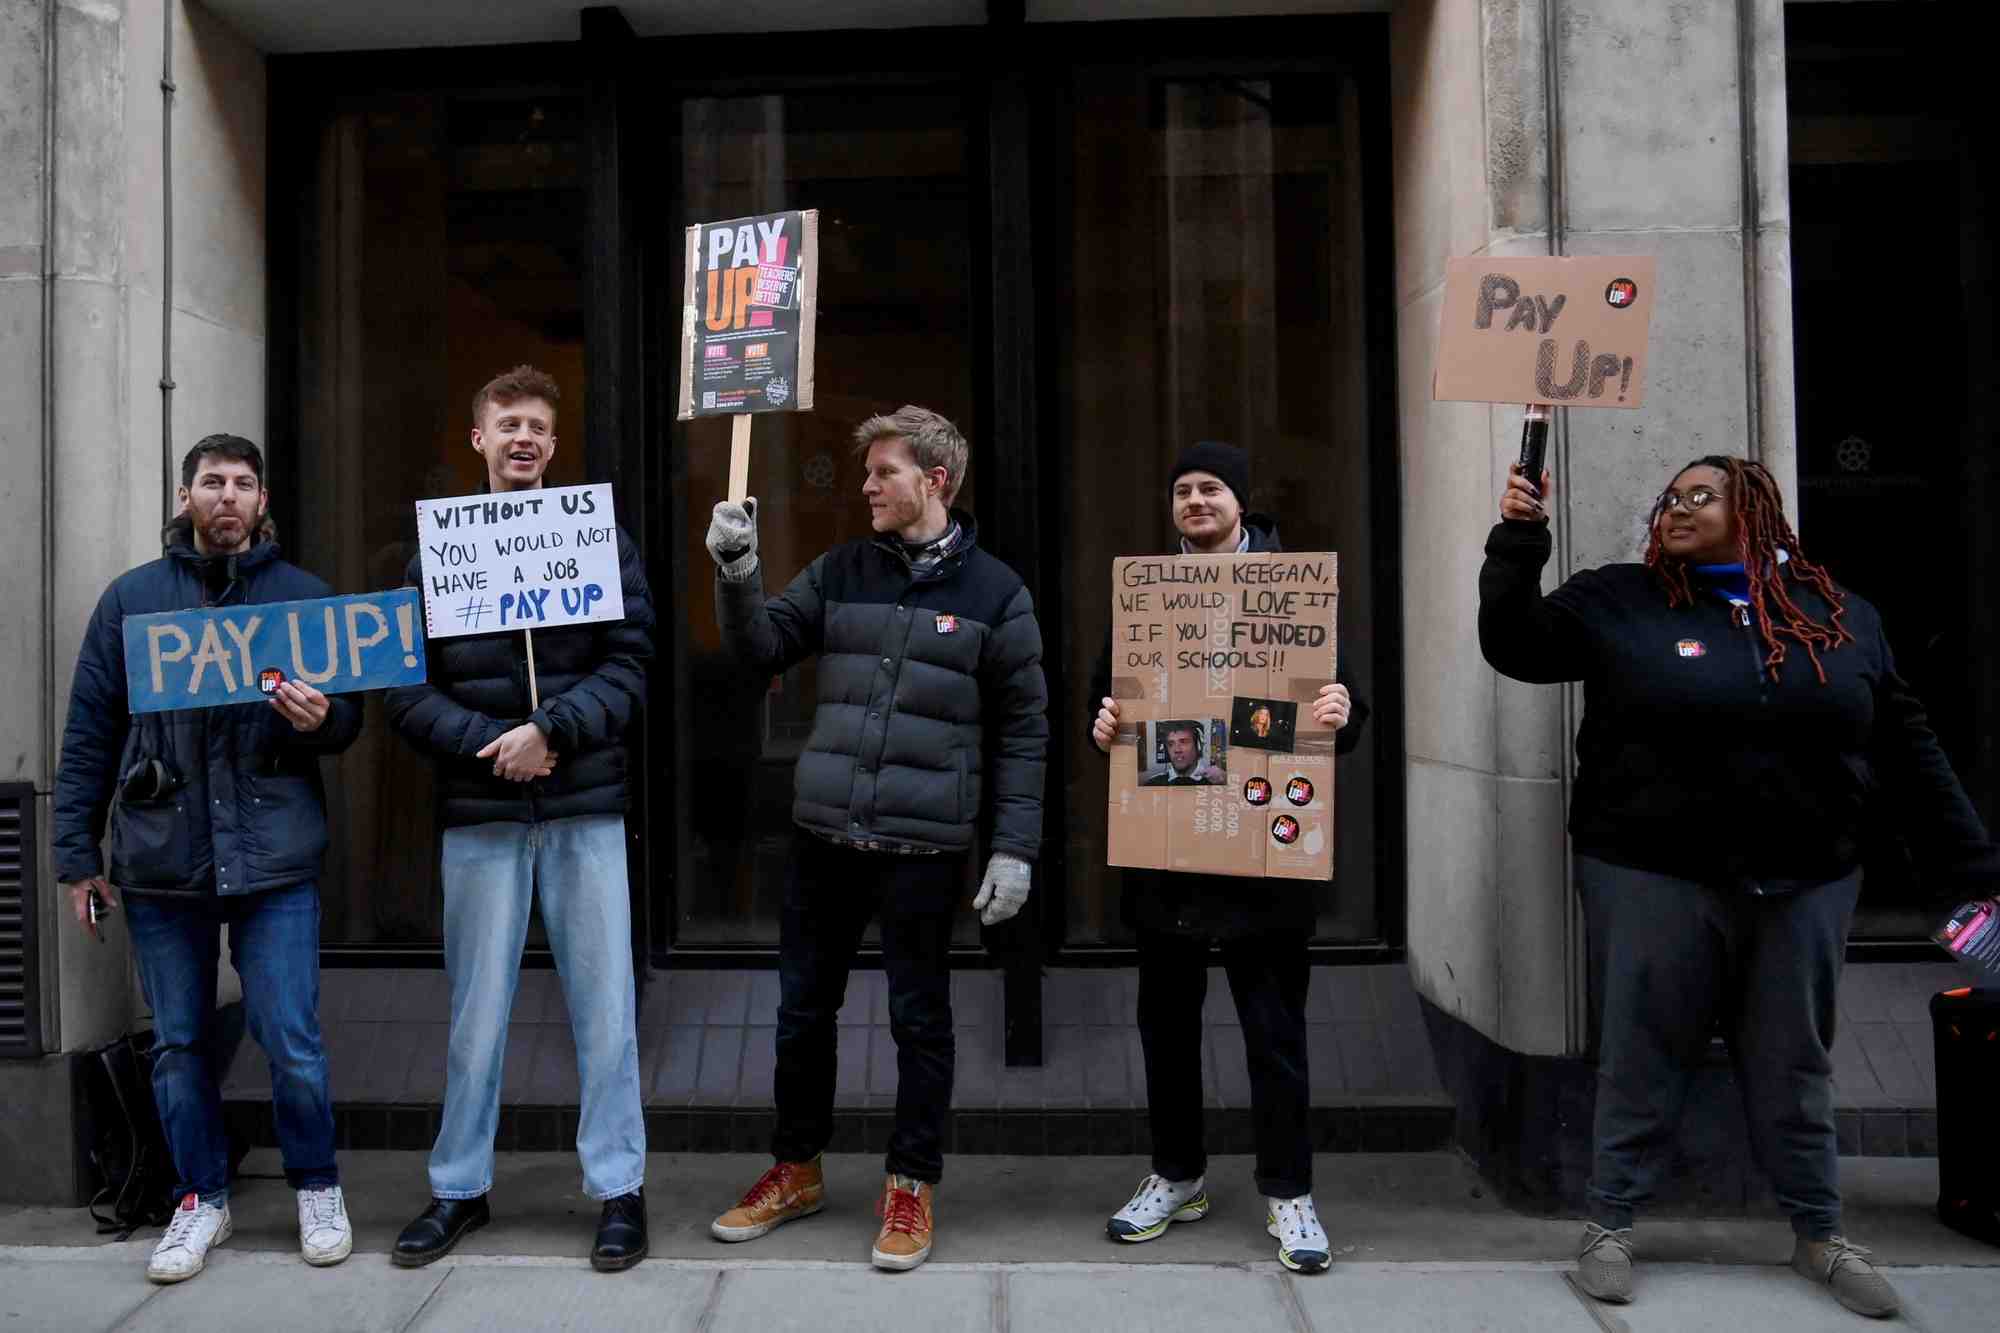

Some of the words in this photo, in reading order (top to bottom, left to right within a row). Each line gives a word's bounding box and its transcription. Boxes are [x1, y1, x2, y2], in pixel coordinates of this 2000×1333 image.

[708, 218, 785, 270] PAY
[1611, 282, 1632, 291] PAY
[1473, 273, 1566, 334] PAY
[1536, 339, 1633, 402] UP!
[433, 499, 543, 529] WITHOUT
[561, 491, 596, 515] US
[429, 542, 477, 567] YOU
[495, 531, 563, 557] WOULD
[577, 527, 615, 548] NOT
[432, 571, 488, 597] HAVE
[514, 565, 525, 584] A
[544, 558, 579, 582] JOB
[1123, 561, 1220, 587] GILLIAN
[1233, 561, 1329, 585] KEEGAN,
[456, 596, 493, 629] #
[500, 588, 550, 625] PAY
[561, 583, 603, 616] UP
[1120, 592, 1149, 613] WE
[1162, 592, 1225, 611] WOULD
[1242, 590, 1300, 617] LOVE
[1304, 592, 1336, 609] IT
[147, 615, 263, 694] PAY
[288, 603, 418, 684] UP!
[1129, 624, 1162, 642] IF
[1176, 623, 1207, 642] YOU
[1232, 622, 1326, 648] FUNDED
[1128, 652, 1164, 668] OUR
[1177, 651, 1285, 672] SCHOOLS!!
[262, 671, 281, 680] PAY
[1248, 781, 1265, 790] PAY
[1291, 780, 1309, 790] PAY
[1279, 817, 1296, 827] PAY
